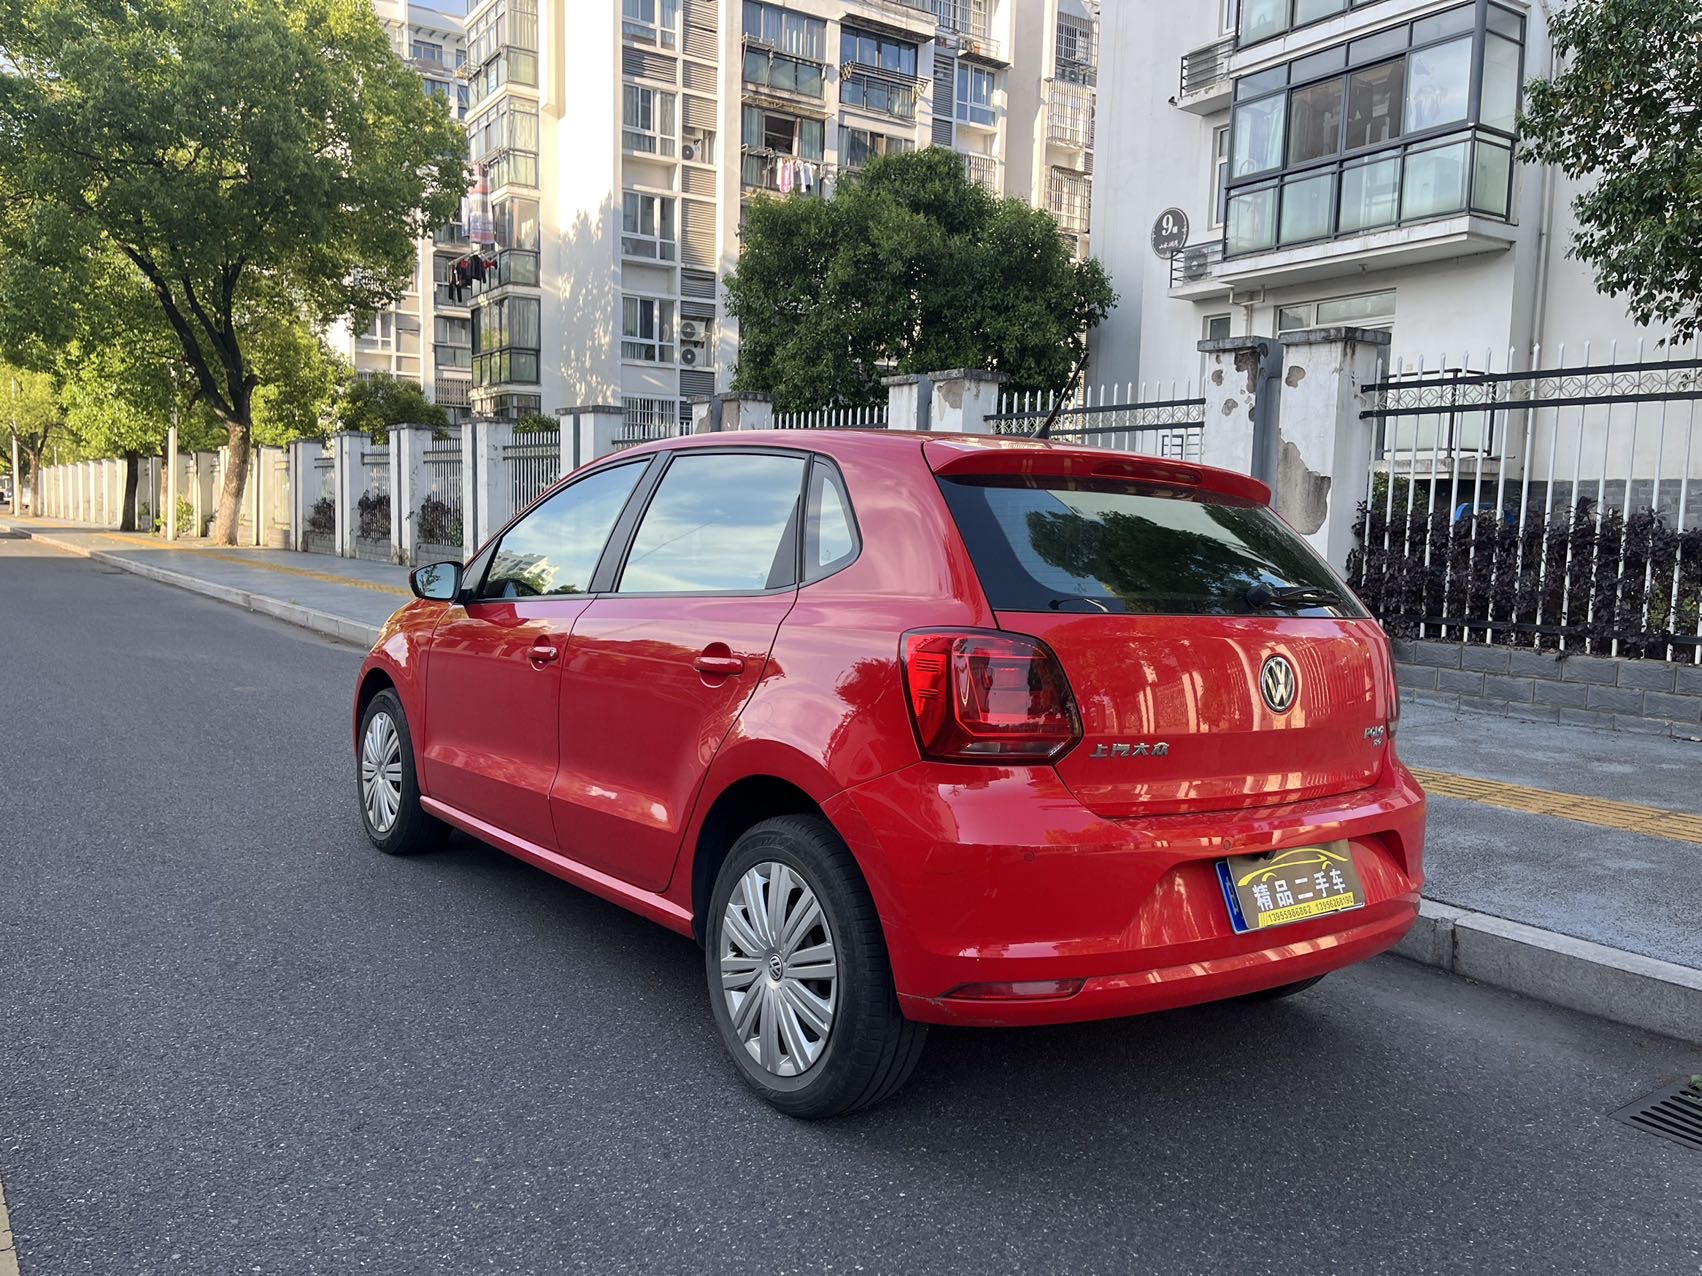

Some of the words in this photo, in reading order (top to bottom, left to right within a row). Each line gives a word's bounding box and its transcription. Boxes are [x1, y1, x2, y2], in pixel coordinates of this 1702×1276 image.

[1089, 742, 1170, 758] 上汽大众
[1252, 868, 1346, 911] 精品二手车
